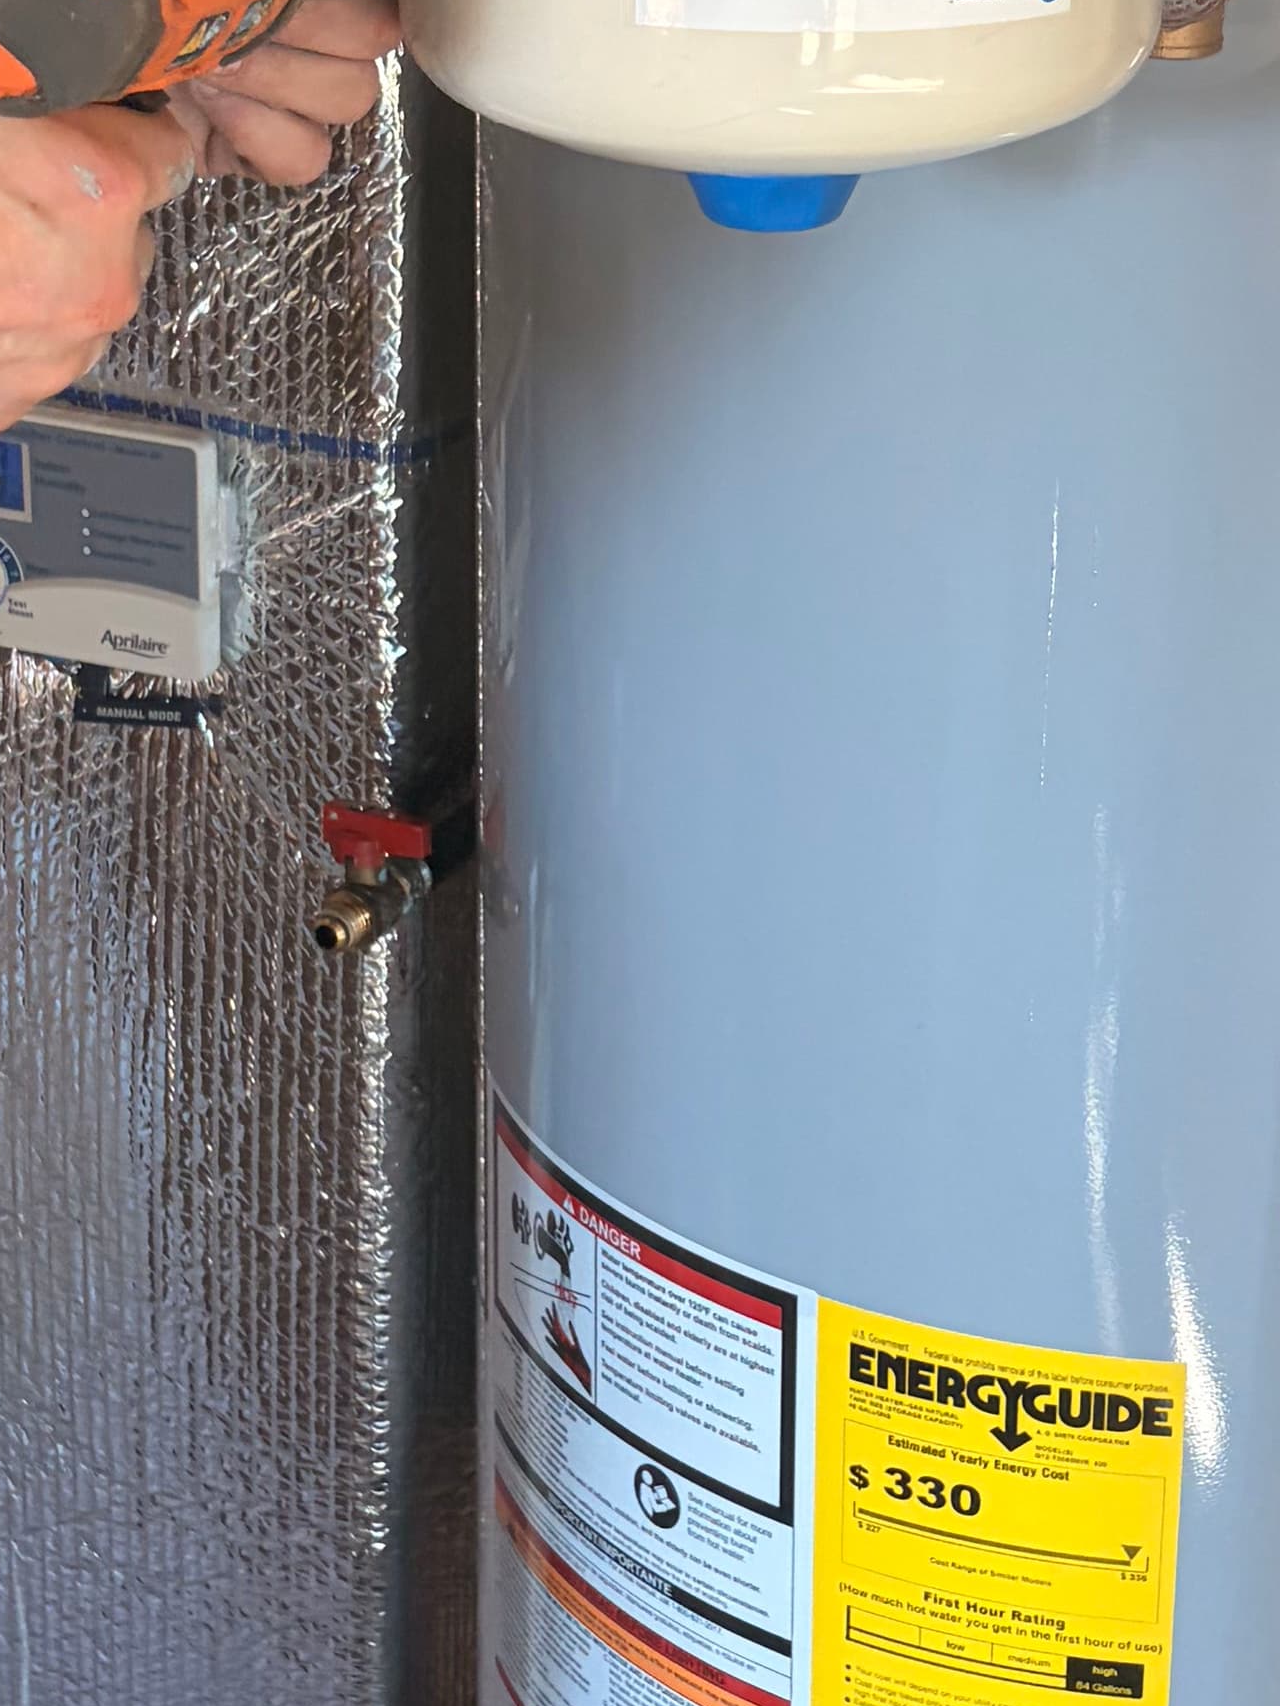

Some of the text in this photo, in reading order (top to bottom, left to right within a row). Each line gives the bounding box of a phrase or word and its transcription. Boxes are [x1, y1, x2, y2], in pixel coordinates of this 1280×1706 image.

[100, 629, 168, 655] Aprilaire
[96, 705, 182, 723] MANUAL MODE
[579, 1206, 641, 1261] DANGER
[849, 1342, 1174, 1445] ENERGYGUIDE
[887, 1435, 1069, 1480] Estimated Yearly Energy Cost
[847, 1463, 980, 1515] $ 330
[838, 1582, 1163, 1653] (How much hot water you get in the first hour of use)
[923, 1591, 1065, 1630] First Hour Rating
[945, 1640, 965, 1651] low
[1091, 1666, 1118, 1677] high
